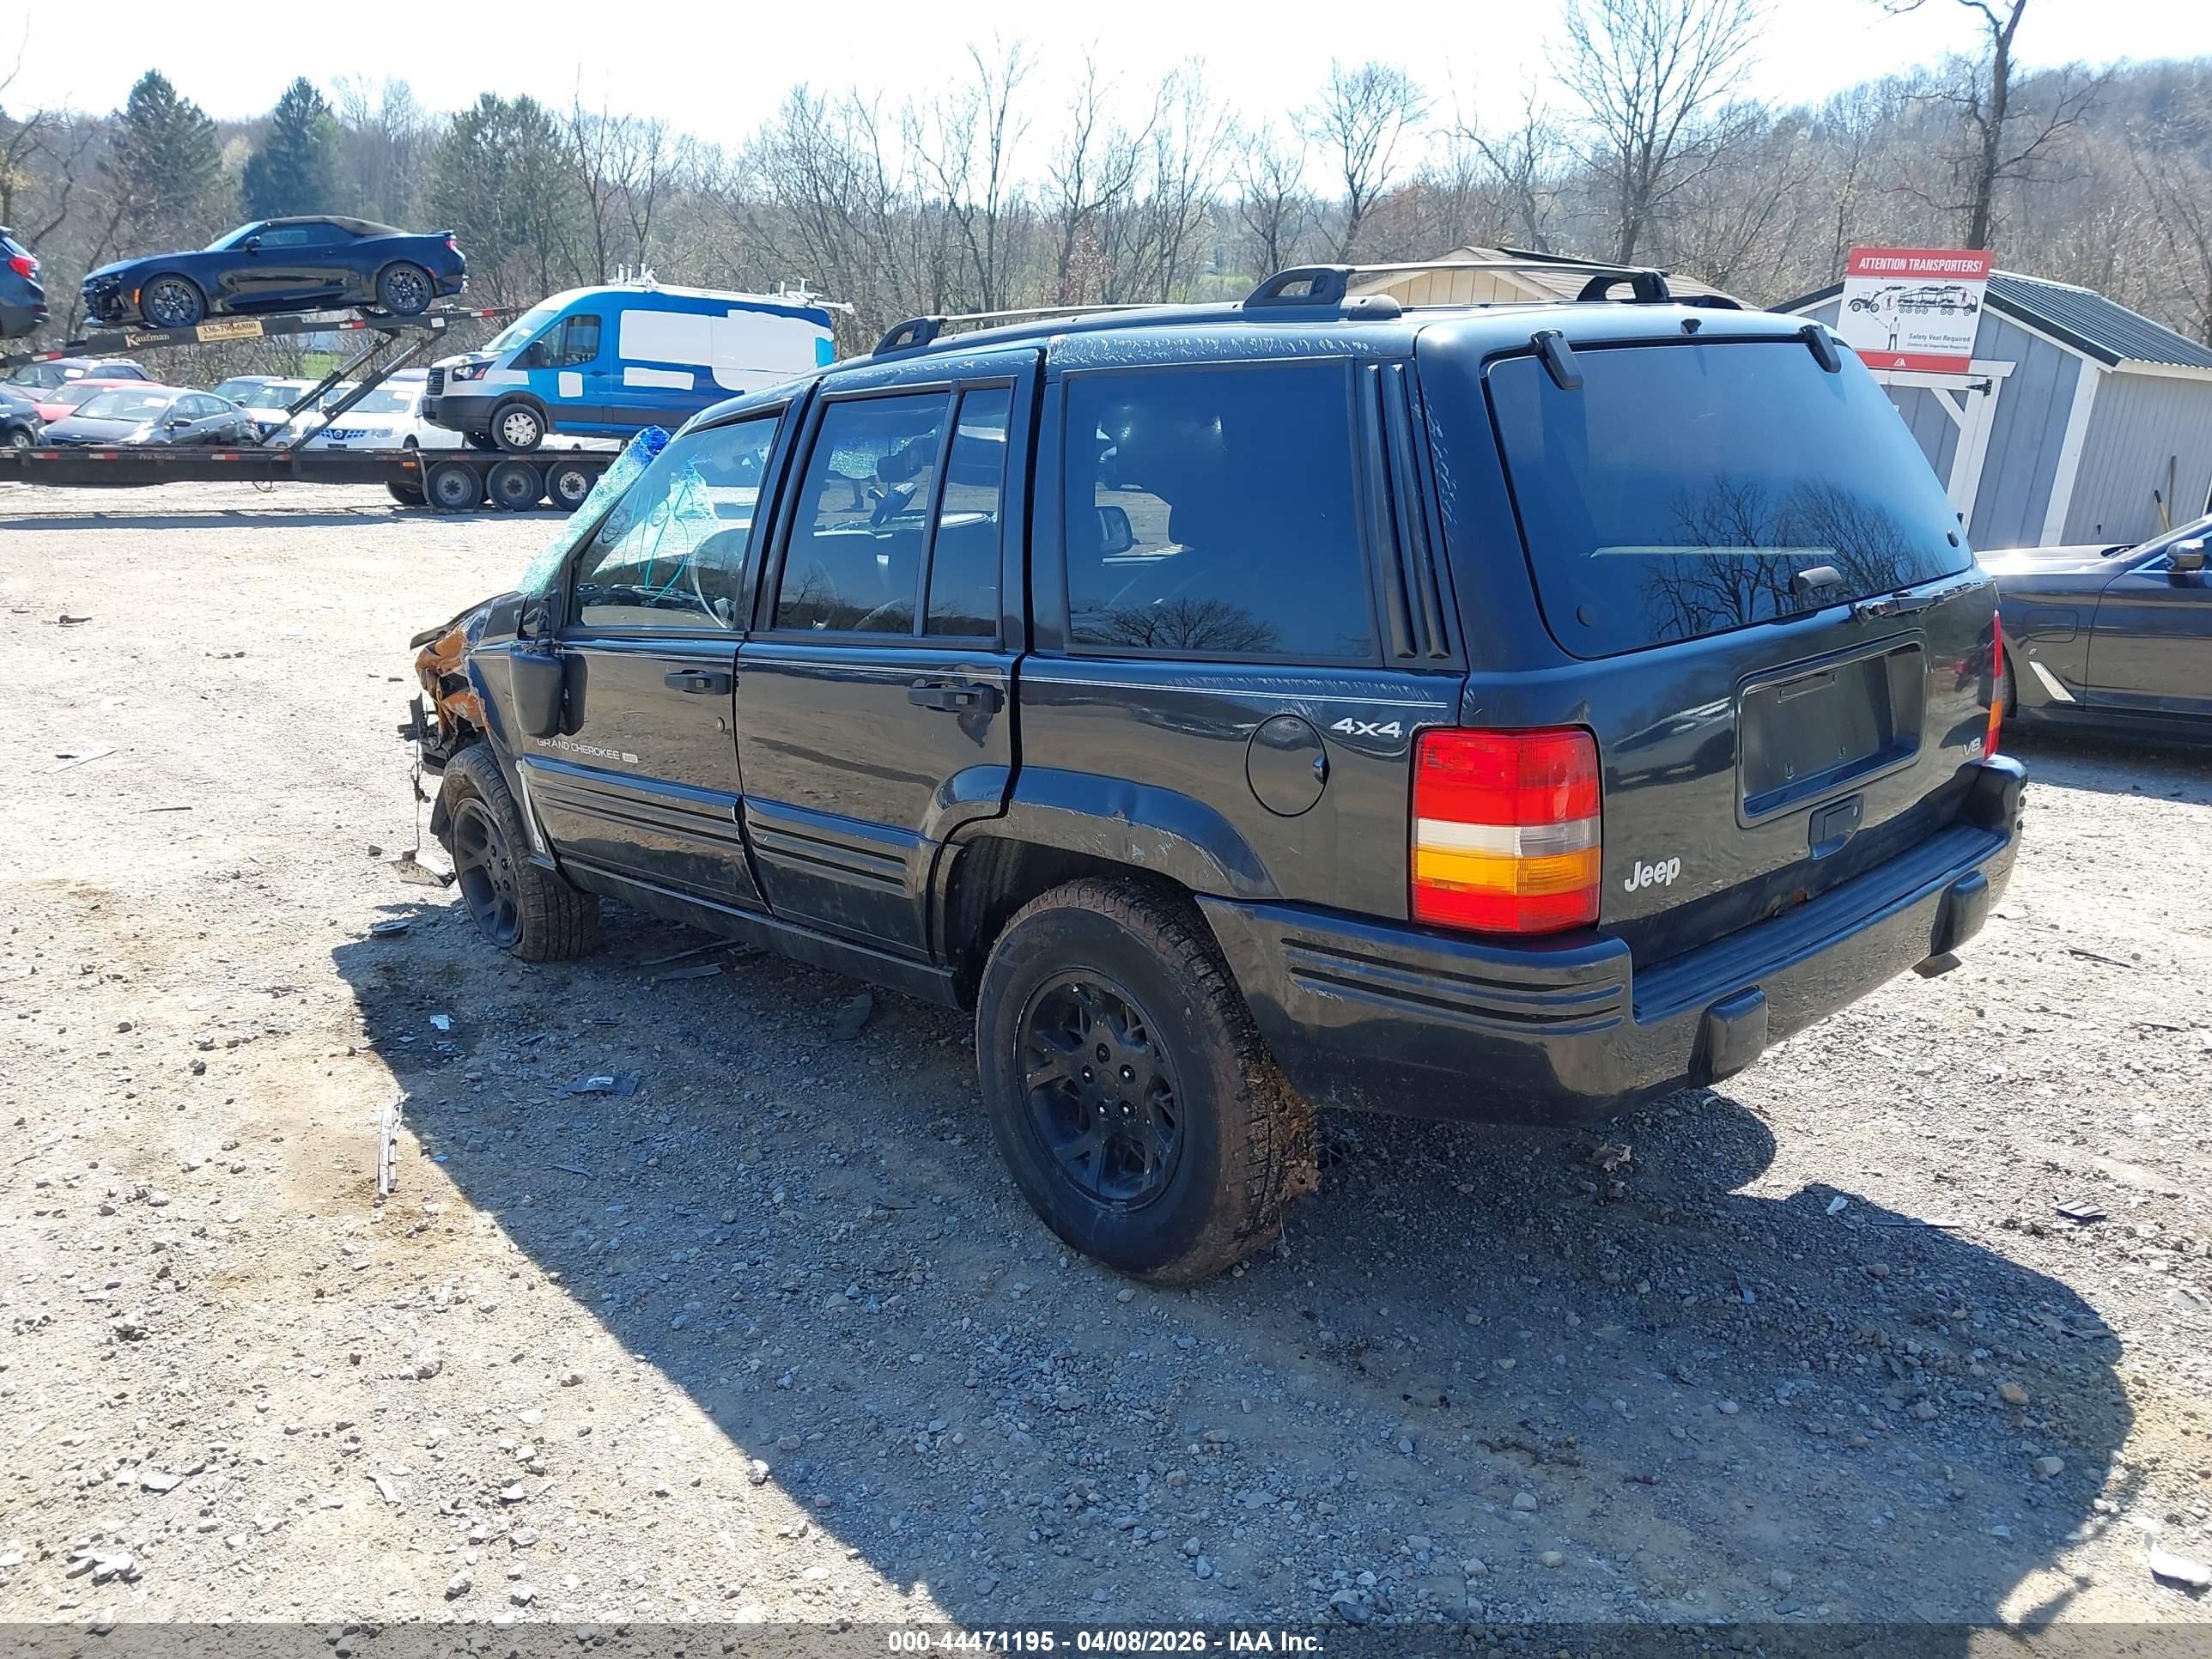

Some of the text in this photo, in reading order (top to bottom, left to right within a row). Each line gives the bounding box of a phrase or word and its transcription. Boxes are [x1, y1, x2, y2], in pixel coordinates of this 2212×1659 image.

[1859, 257, 1984, 273] ATTENTION TRANSPORTERS!
[202, 322, 257, 334] 336-790-6800
[125, 333, 170, 348] Kaufman
[1909, 332, 1927, 341] Safety
[1942, 334, 1972, 343] Required
[536, 738, 570, 751] GRAND
[570, 742, 621, 760] CHEROKEE
[1963, 736, 1981, 756] V8
[1624, 857, 1680, 892] Jeep
